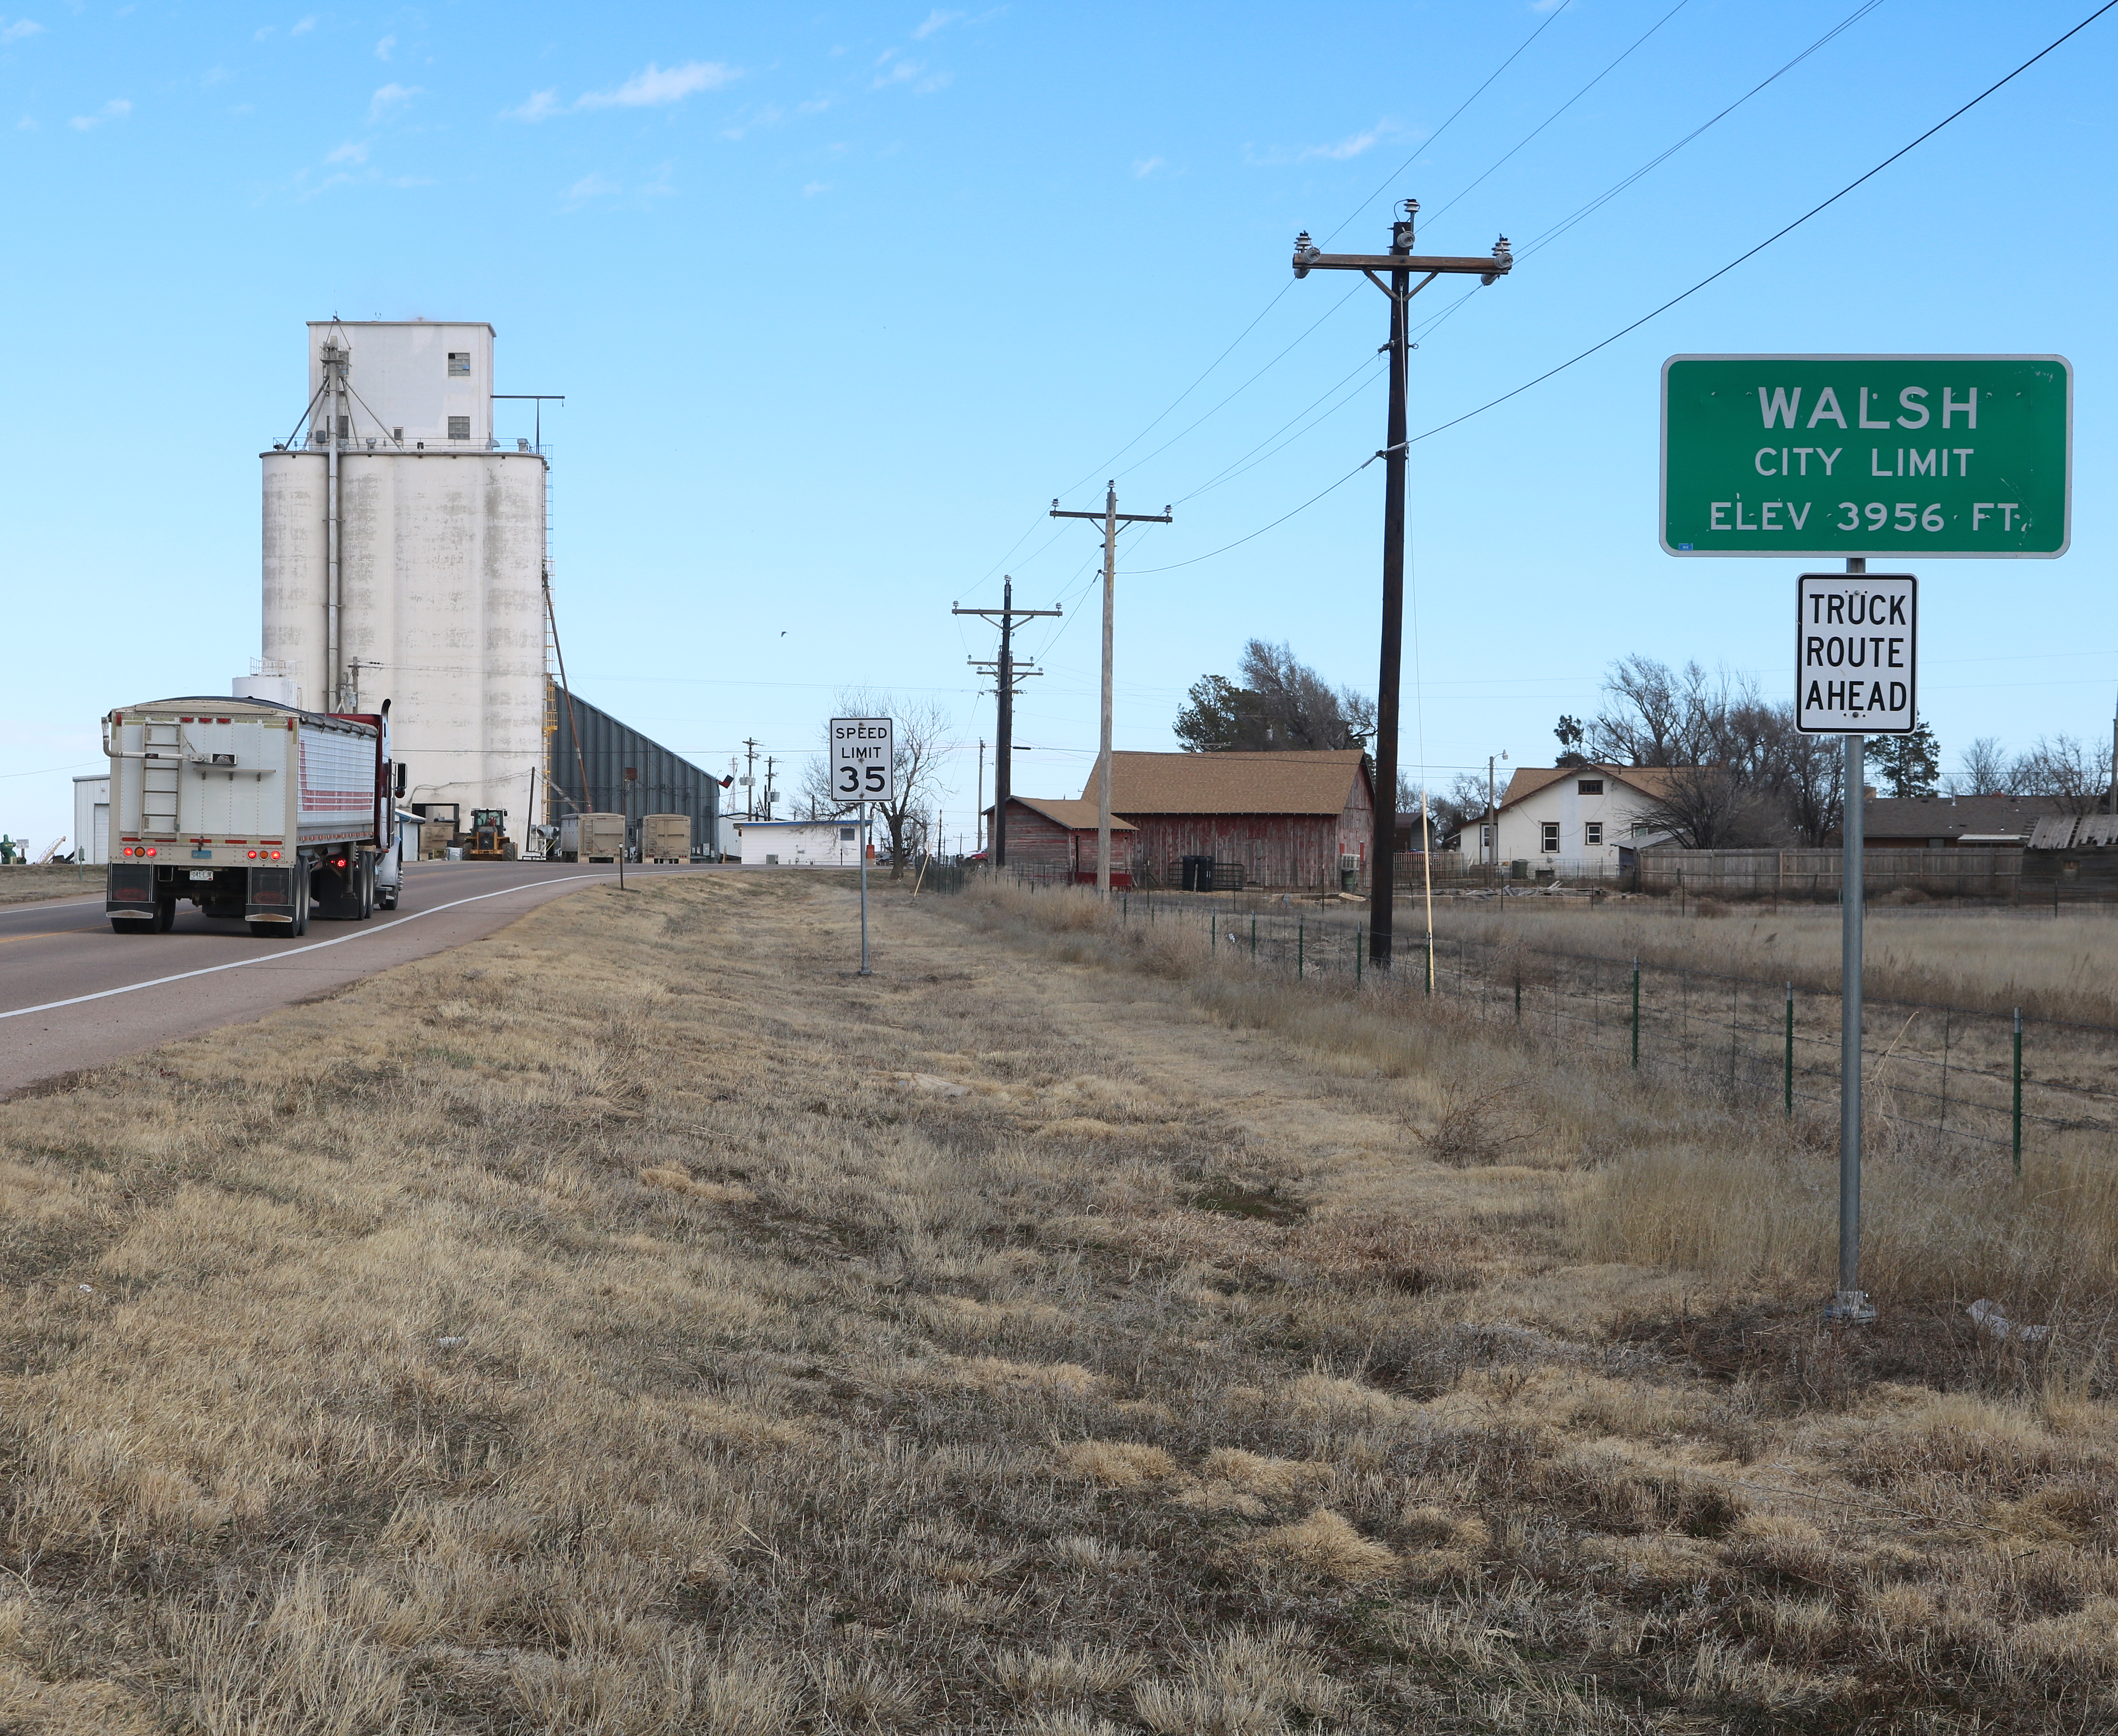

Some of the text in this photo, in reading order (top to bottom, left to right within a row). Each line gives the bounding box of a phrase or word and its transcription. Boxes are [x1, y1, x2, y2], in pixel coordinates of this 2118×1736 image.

[1759, 387, 1977, 429] WALSH
[1755, 448, 1973, 476] CITY LIMIT
[1711, 502, 1811, 529] ELEV
[1838, 502, 1944, 531] 3956
[1810, 594, 1906, 625] TRUCK
[1807, 636, 1904, 667] ROUTE
[1806, 681, 1907, 711] AHEAD
[836, 727, 887, 739] SPEED
[842, 747, 881, 758] LIMIT
[839, 766, 885, 792] 35
